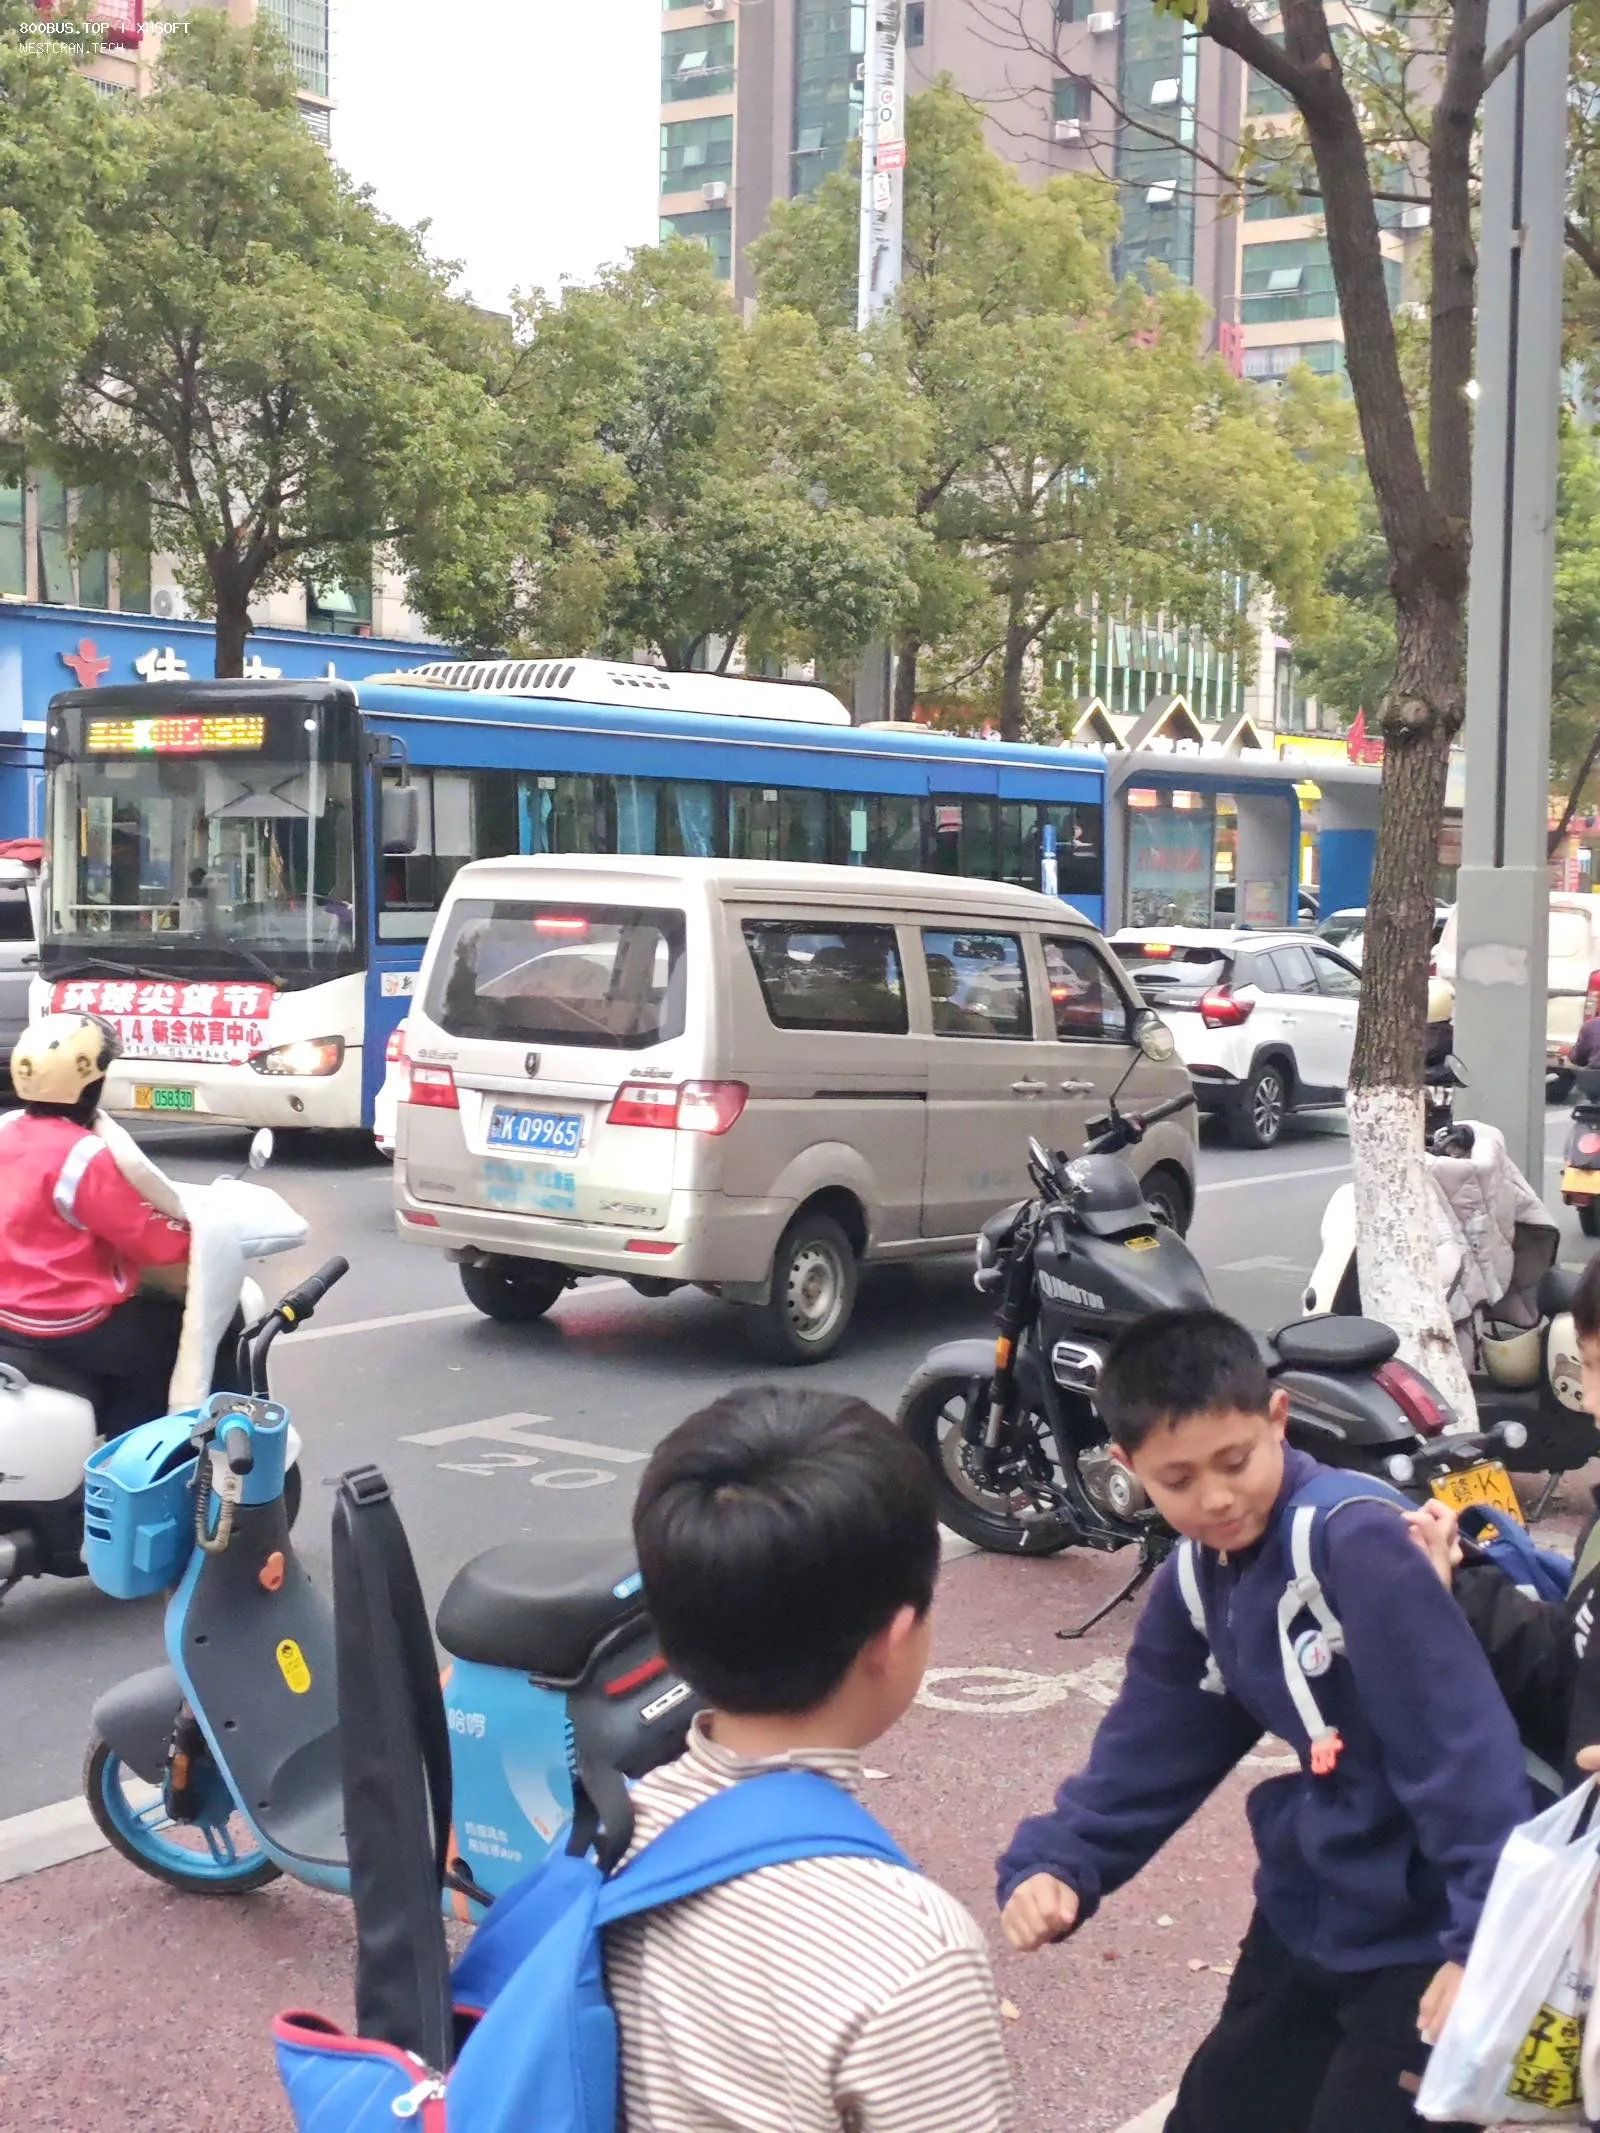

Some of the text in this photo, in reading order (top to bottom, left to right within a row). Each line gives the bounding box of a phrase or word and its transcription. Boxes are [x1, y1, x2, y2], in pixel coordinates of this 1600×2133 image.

[60, 982, 264, 1017] 环球尖货节
[152, 1019, 264, 1047] 新余体育中心
